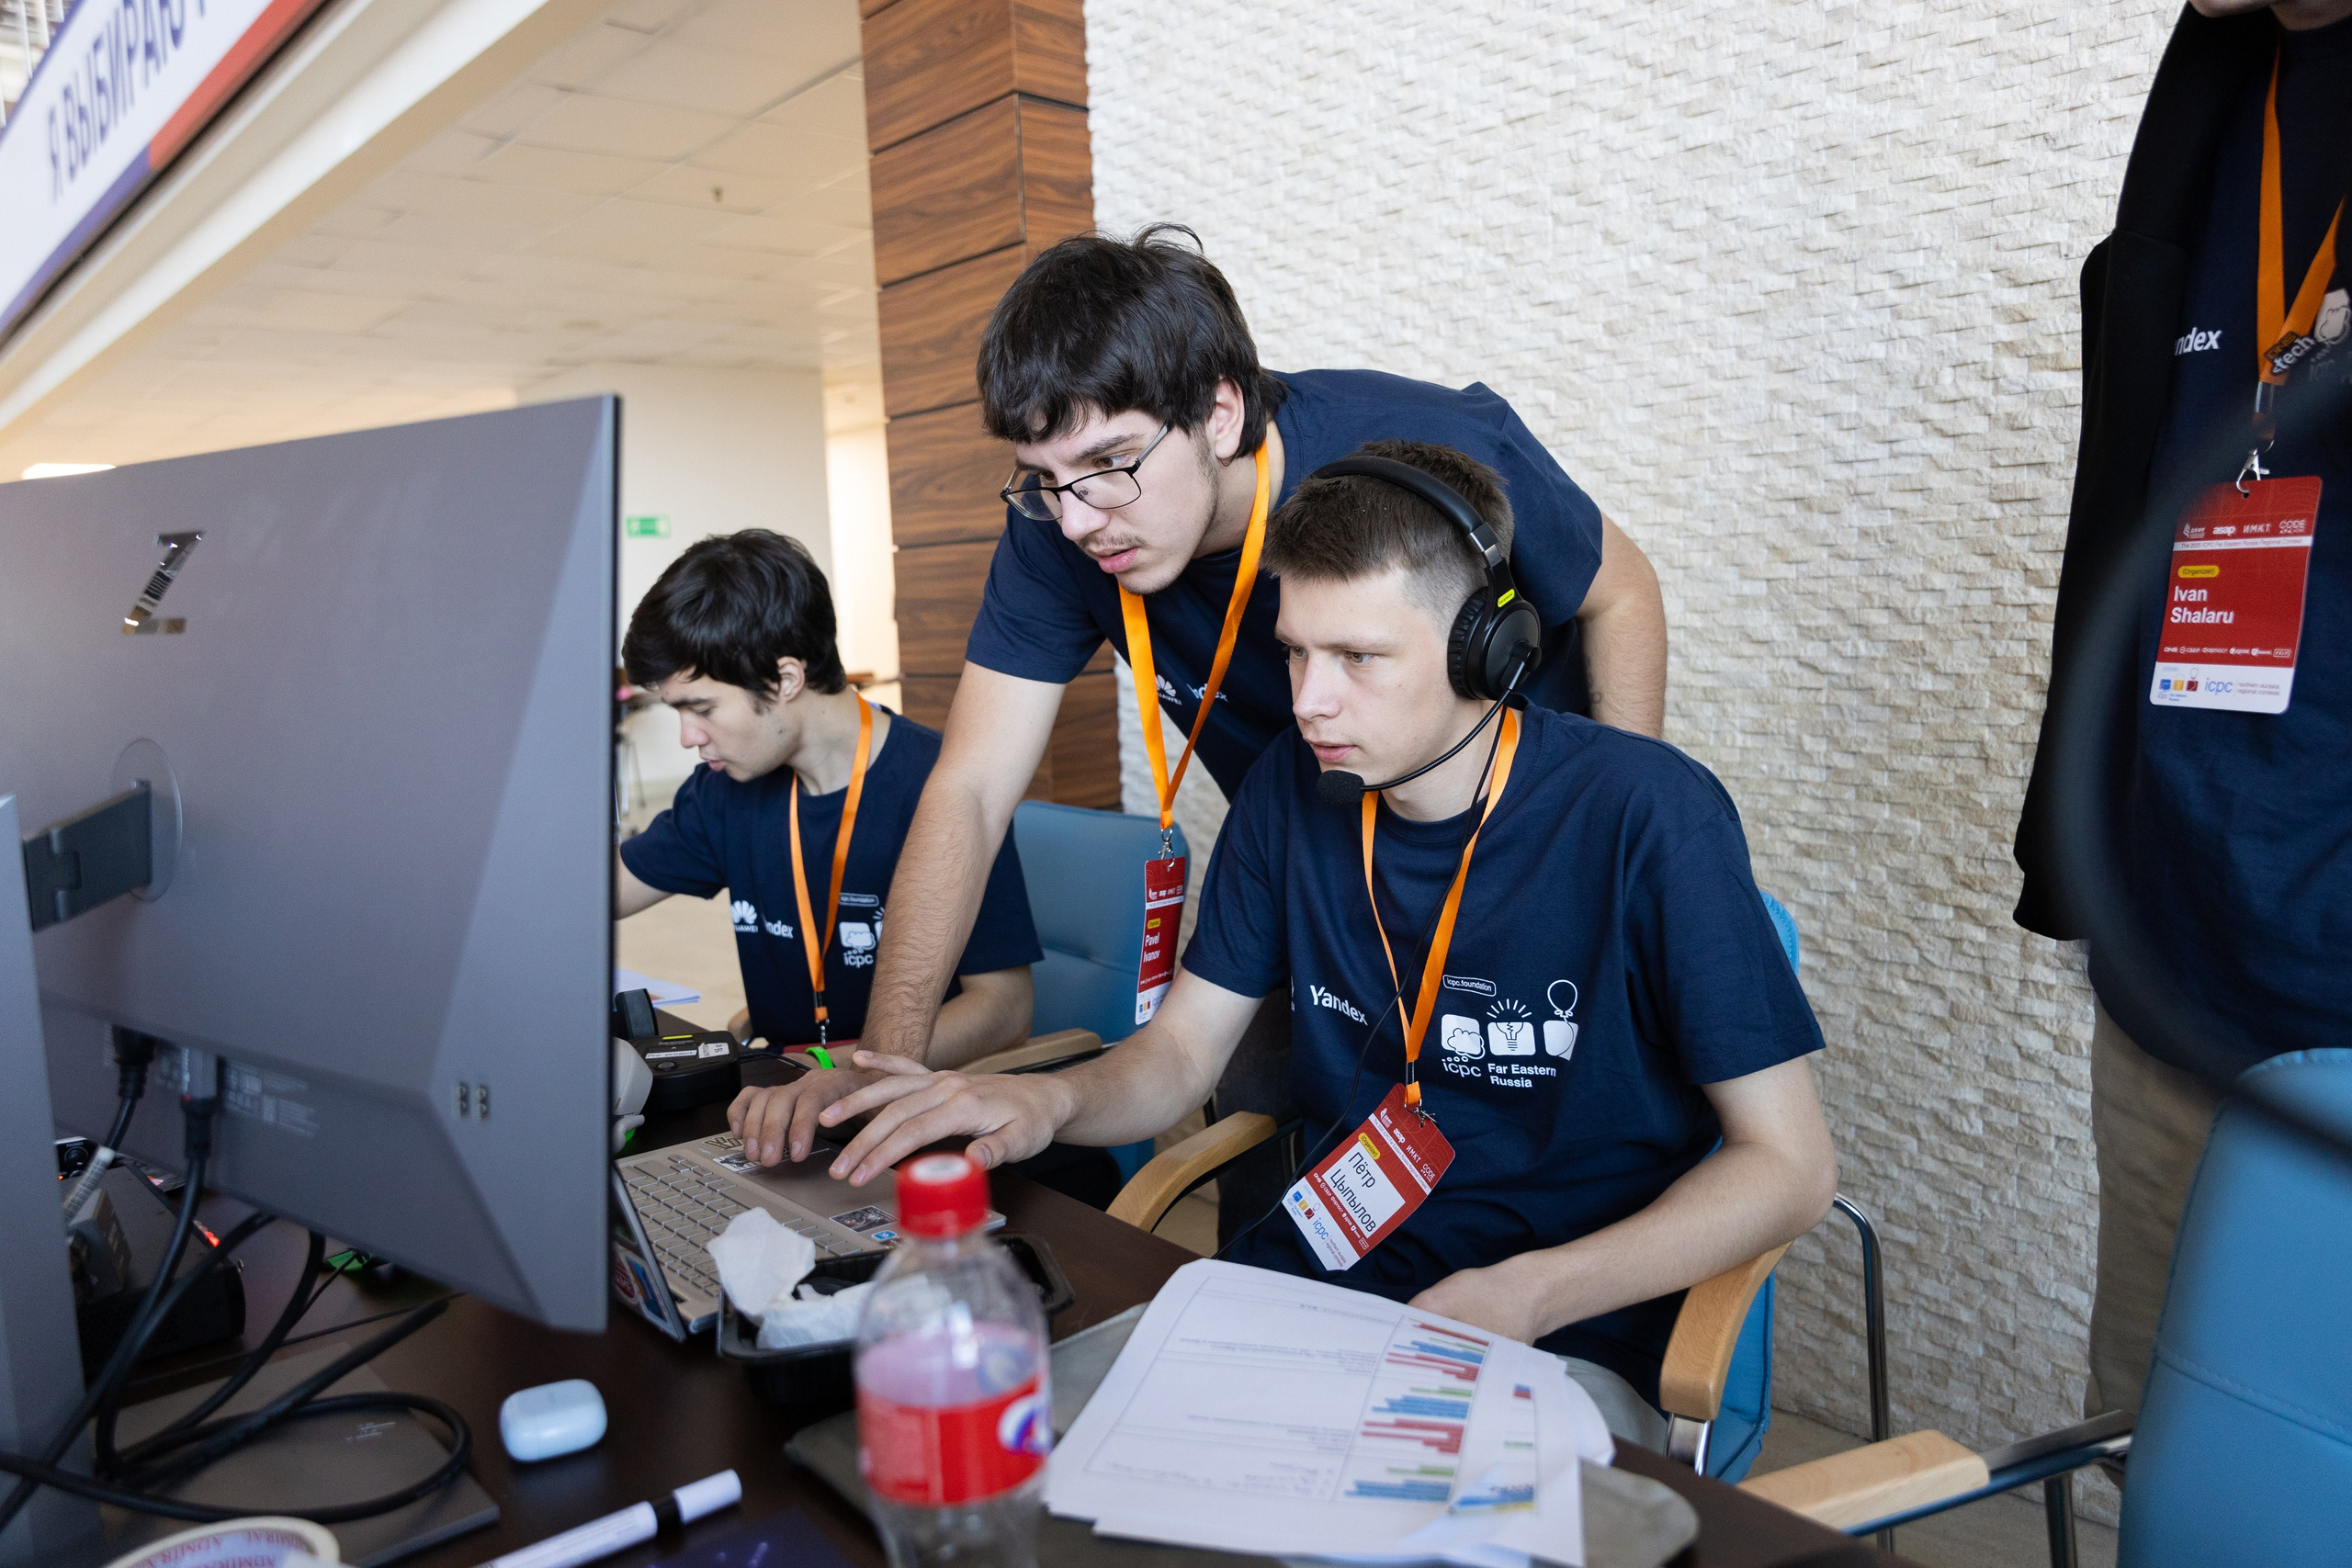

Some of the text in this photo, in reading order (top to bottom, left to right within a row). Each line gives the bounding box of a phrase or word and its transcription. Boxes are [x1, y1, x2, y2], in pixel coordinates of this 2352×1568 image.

[2175, 327, 2222, 356] ndex
[2174, 585, 2208, 602] Ivan
[2170, 607, 2234, 624] Shalaru
[2205, 677, 2233, 695] icpc
[734, 924, 759, 933] UAWEI
[765, 919, 794, 939] ndex
[1145, 932, 1160, 947] Pavel
[843, 952, 874, 968] icpc
[1143, 950, 1160, 963] Ivanov
[1447, 977, 1492, 991] icpc.foundation
[1310, 985, 1368, 1026] Yandex
[1442, 1058, 1482, 1077] icpc
[1487, 1063, 1556, 1077] Far Eastern
[1490, 1076, 1532, 1088] Russia
[1406, 1145, 1420, 1162] ИМКТ
[1349, 1152, 1376, 1188] Пётр
[1330, 1168, 1376, 1232] Цыпылов
[1313, 1218, 1329, 1240] icpc
